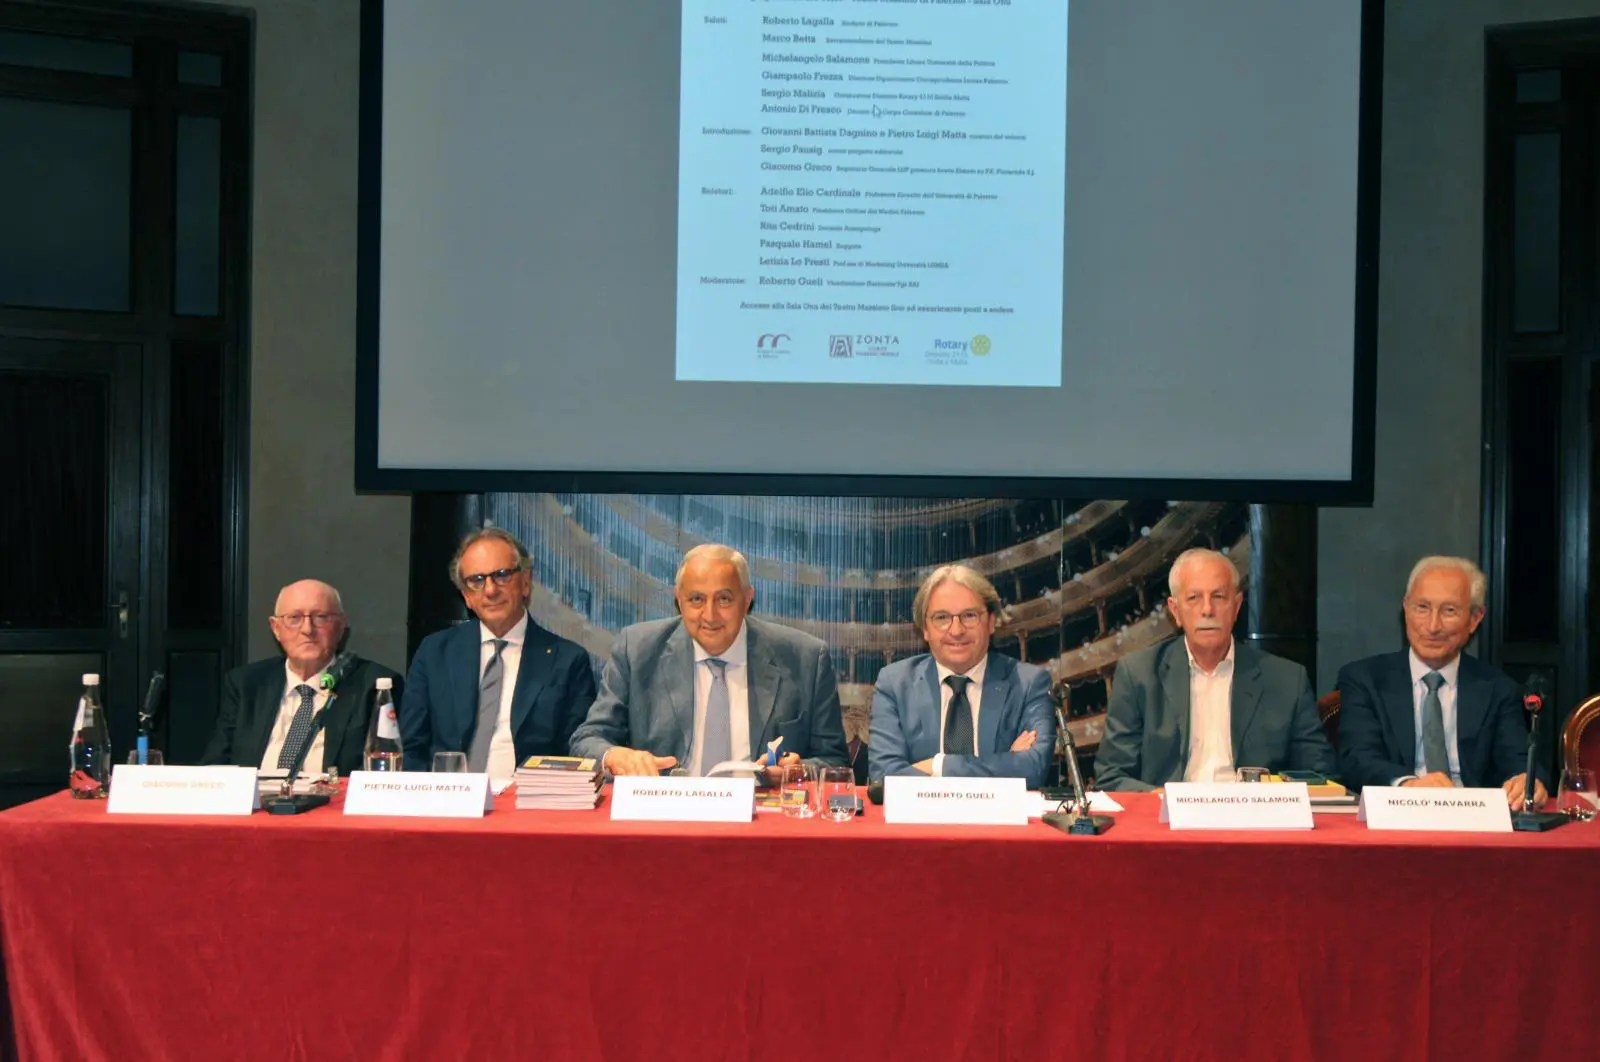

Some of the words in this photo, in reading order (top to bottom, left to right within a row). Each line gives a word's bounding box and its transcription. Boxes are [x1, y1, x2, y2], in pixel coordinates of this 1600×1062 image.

[762, 16, 800, 26] Roberto
[801, 17, 834, 28] Lagalla
[762, 34, 791, 43] Marco
[793, 34, 816, 44] Betta
[762, 53, 824, 64] Michelangelo
[826, 54, 871, 65] Salamone
[761, 71, 812, 82] Giampaolo
[761, 88, 791, 100] Sergio
[793, 89, 826, 99] Malizia
[761, 104, 797, 113] Antonio
[799, 104, 809, 114] Di
[811, 104, 842, 114] Fresco
[761, 127, 802, 137] Giovanni
[804, 127, 837, 137] Battista
[839, 128, 878, 140] Dagnino
[887, 129, 916, 139] Pietro
[917, 129, 939, 141] Luigi
[941, 130, 967, 140] Matta
[760, 144, 791, 155] Sergio
[760, 162, 802, 172] Giacomo
[760, 187, 794, 197] Adelfio
[796, 187, 814, 197] Elio
[816, 188, 861, 198] Cardinale
[760, 204, 777, 213] Toti
[778, 204, 809, 214] Amato
[760, 221, 778, 231] Rita
[779, 221, 815, 231] Cedrini
[759, 239, 801, 251] Pasquale
[802, 240, 833, 249] Hamel
[759, 257, 789, 266] Letizia
[791, 257, 802, 266] Lo
[804, 257, 830, 267] Presti
[759, 276, 796, 286] Roberto
[797, 276, 823, 287] Gueli
[856, 334, 900, 345] ZONTA
[934, 339, 969, 352] Rotary
[364, 783, 401, 791] PIETRO
[404, 784, 432, 792] LUIGI
[435, 784, 472, 793] MATTA
[632, 788, 682, 797] ROBERTO
[685, 789, 733, 798] LAGALLA
[917, 791, 963, 799] ROBERTO
[965, 792, 995, 800] GUELI
[1176, 796, 1249, 804] MICHELANGELO
[1251, 796, 1301, 804] SALAMONE
[1434, 800, 1486, 808] NAVARRA
